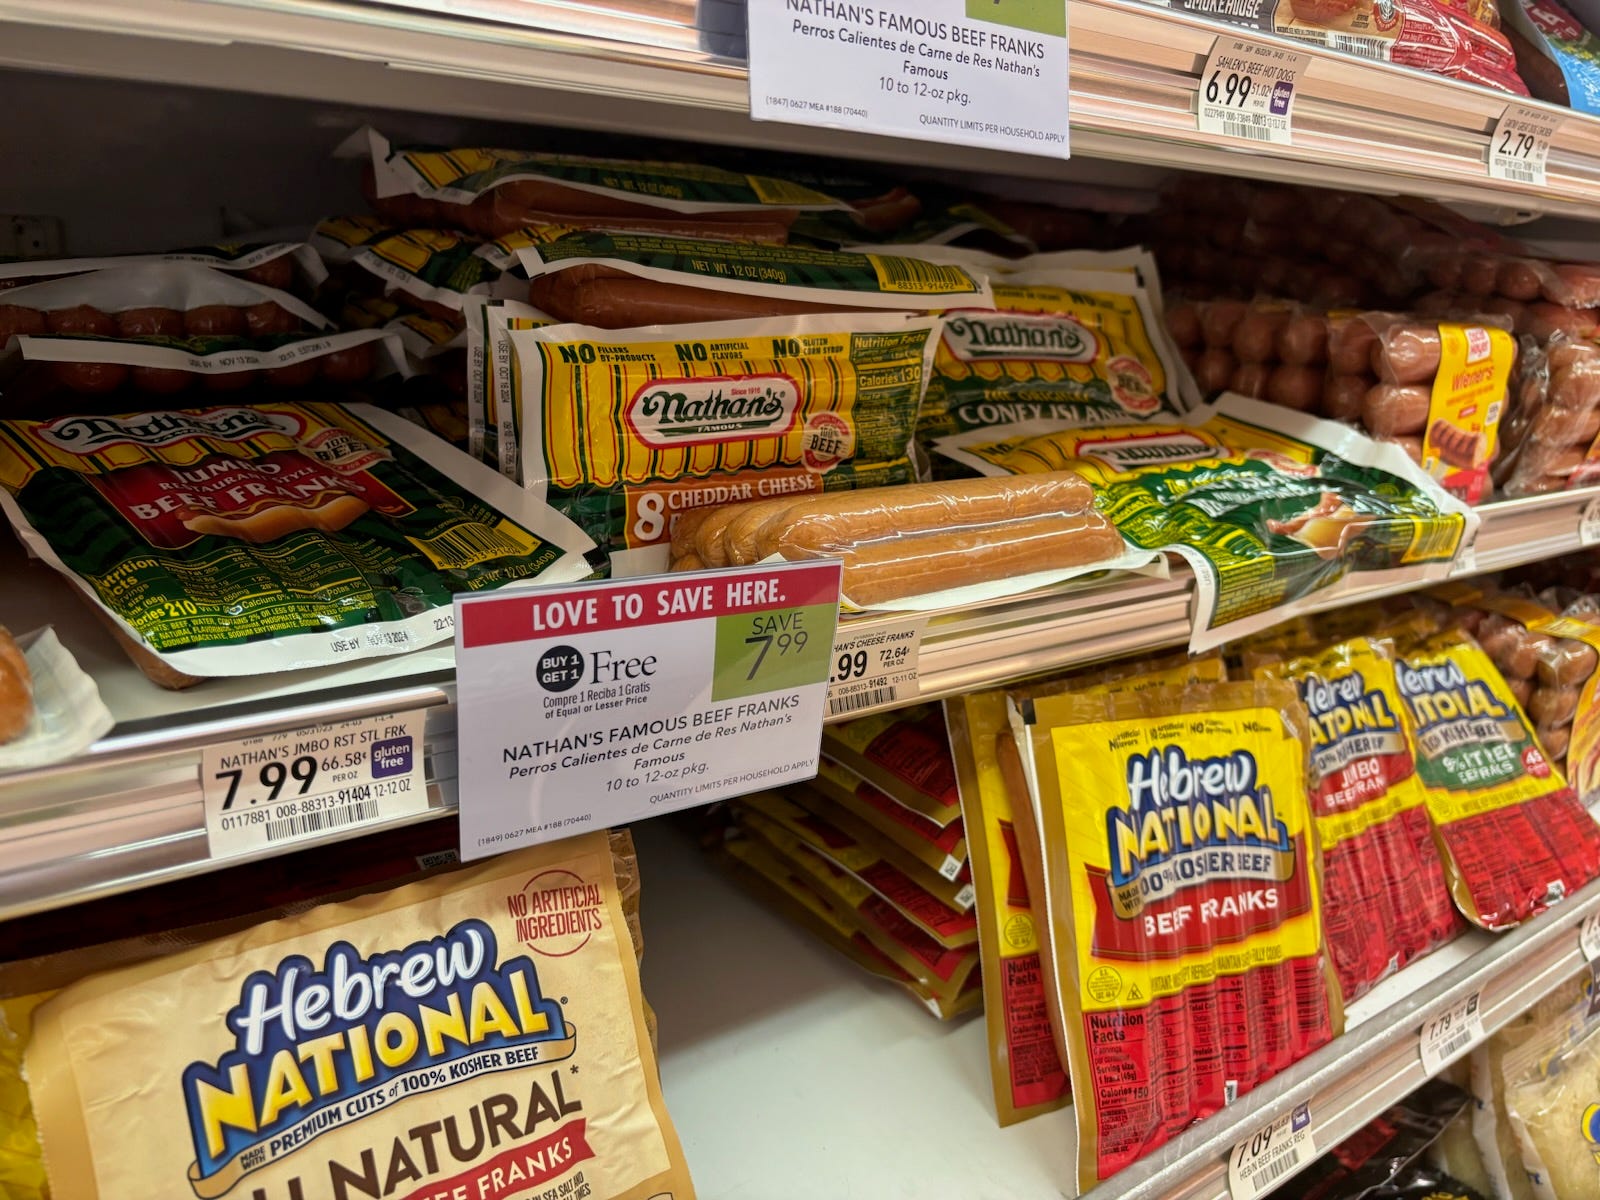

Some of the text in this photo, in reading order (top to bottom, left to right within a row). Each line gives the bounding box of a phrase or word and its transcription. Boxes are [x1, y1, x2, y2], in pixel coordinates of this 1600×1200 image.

[785, 0, 1044, 60] NATHAN'S FAMOUS BEEF FRANKS
[792, 19, 1041, 78] Perros Calientes de Carne de Res Nathan's
[903, 60, 949, 81] Famous
[1215, 55, 1297, 81] SAHLEN'S BEEF HOT DOGS
[879, 76, 972, 108] 10 to 12-oz pkg.
[1205, 70, 1252, 108] 6.99
[1272, 86, 1291, 99] gluten
[1273, 97, 1285, 109] free
[919, 113, 1065, 144] QUANTITY LIMITS PER HOUSEHOLD APPLY
[1498, 129, 1535, 158] 2.79
[691, 259, 710, 273] NET
[731, 264, 743, 277] 12
[744, 265, 757, 278] OZ
[758, 266, 787, 284] (340g)
[710, 342, 750, 352] ARTIFICIAL
[948, 319, 1086, 351] Nathan's
[558, 338, 800, 364] NO NO NO
[597, 346, 629, 355] FILLERS
[600, 353, 657, 363] BY-PRODUCTS
[712, 350, 744, 360] FLAVORS
[859, 366, 921, 387] Calories 130
[642, 386, 785, 425] Nathan's
[958, 403, 1043, 424] CONEY
[697, 422, 743, 433] FAMOUS
[810, 437, 842, 455] BEEF
[128, 492, 217, 520] BEEF
[633, 492, 665, 542] 8
[668, 484, 752, 510] CHEDDAR
[758, 473, 816, 497] CHEESE
[164, 599, 198, 618] 210
[532, 577, 787, 632] LOVE TO SAVE HERE.
[751, 611, 804, 636] SAVE
[856, 636, 886, 649] CHEESE
[885, 629, 916, 644] FRANKS
[541, 653, 580, 670] BUY 1
[589, 650, 658, 686] Free
[541, 668, 580, 685] GET 1
[891, 675, 908, 685] 12-11
[543, 692, 578, 710] Compre
[587, 686, 616, 702] Reciba
[624, 681, 651, 697] Gratis
[545, 695, 648, 721] of Equal or Lesser Price
[502, 694, 800, 764] NATHAN'S FAMOUS BEEF FRANKS
[220, 723, 407, 770] NATHAN'S JMBO RST STL FRK
[374, 742, 411, 762] gluten
[508, 713, 793, 780] Perros Calientes de Carne de Res Nathan's
[633, 751, 686, 771] Famous
[332, 770, 359, 784] PER OZ
[381, 755, 404, 770] free
[214, 754, 318, 811] 7.99
[606, 762, 710, 793] 10 to 12-oz pkg.
[649, 758, 816, 804] QUANTITY LIMITS PER HOUSEHOLD APPLY
[1128, 752, 1253, 811] Hebrew
[221, 777, 412, 831] 0117881 008-88313-91404 12-12 OZ
[477, 813, 593, 848] (1849) 0627 MEA #188 (70440)
[1115, 793, 1281, 877] NATIONAL
[507, 883, 604, 919] NO ARTIFICIAL
[1144, 887, 1279, 938] BEEF FRANKS
[515, 907, 603, 943] INGREDIENTS
[236, 928, 485, 1056] Hebrew
[1090, 1012, 1144, 1030] Nutrition
[1430, 1012, 1452, 1041] 7.79
[1092, 1029, 1126, 1044] Facts
[194, 969, 550, 1160] NATIONAL
[269, 1046, 540, 1157] PREMIUM CUTS of 100% KOSHER BEEF
[1100, 1087, 1132, 1099] Calories
[328, 1069, 583, 1200] NATURAL
[1236, 1124, 1273, 1169] 7.09
[1257, 1130, 1306, 1168] BEEF FRANKS REG
[240, 1145, 265, 1163] MADE
[241, 1153, 266, 1171] WITH
[476, 1136, 573, 1200] FRANKS
